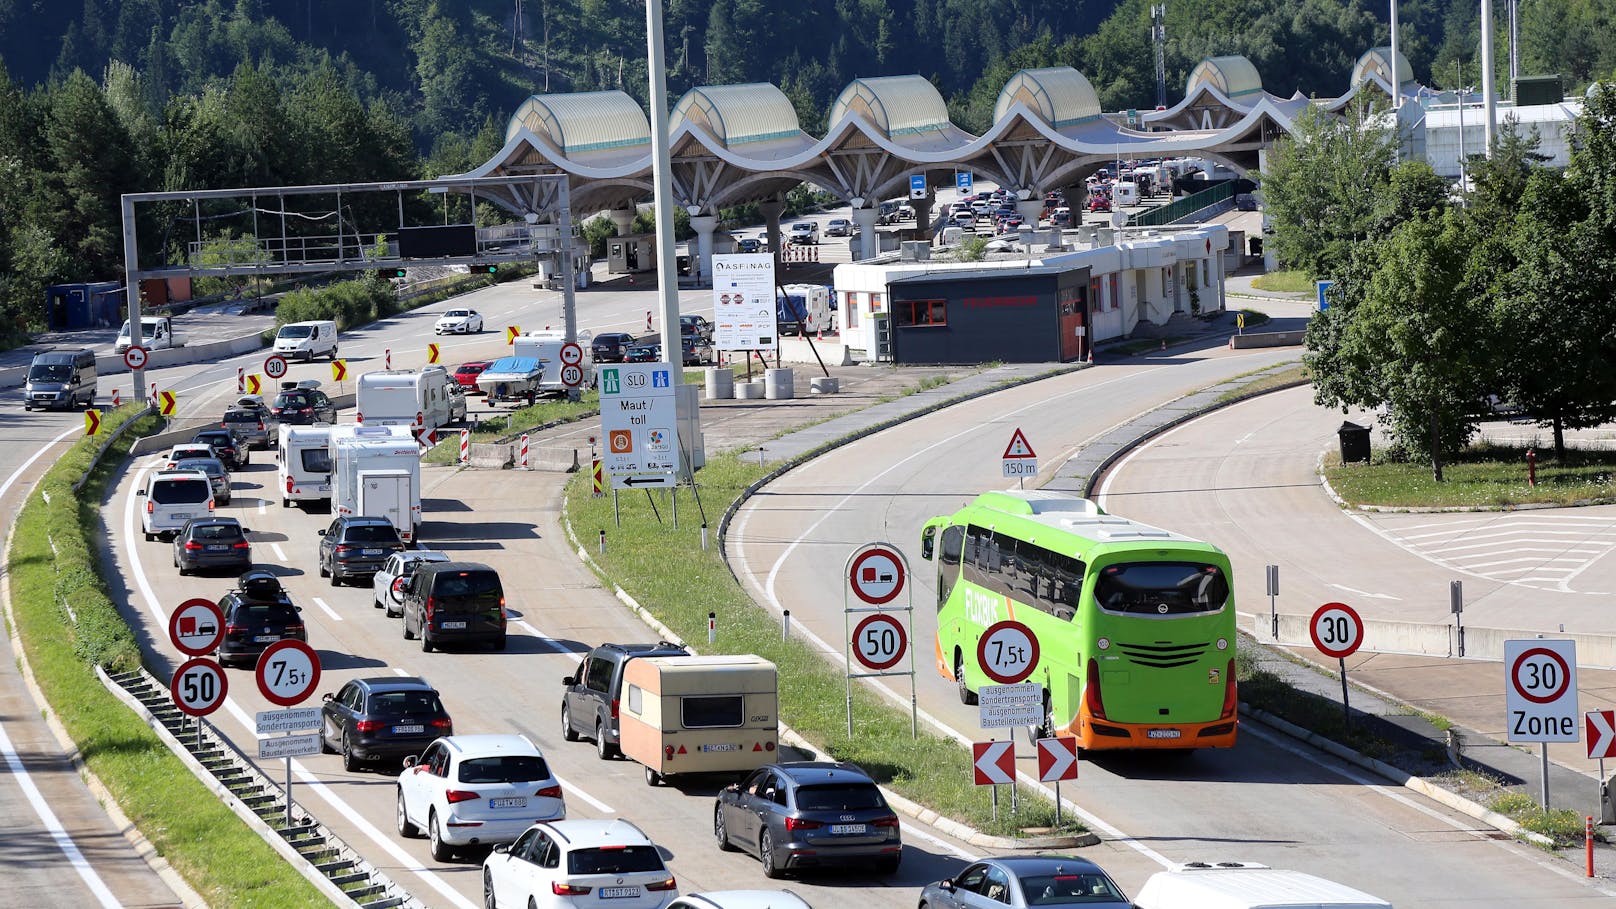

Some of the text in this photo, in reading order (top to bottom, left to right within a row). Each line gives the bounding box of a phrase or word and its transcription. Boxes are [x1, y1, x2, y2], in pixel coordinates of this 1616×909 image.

[269, 361, 281, 373] 30
[566, 369, 578, 381] 30
[627, 375, 645, 386] SLO
[620, 400, 646, 411] Maut
[630, 414, 646, 425] toll
[1005, 463, 1036, 474] 150 m
[1322, 616, 1349, 644] 30
[866, 629, 895, 656] 50
[1526, 662, 1556, 689] 30
[184, 672, 215, 703] 50
[985, 684, 1035, 695] ausgenommen
[981, 694, 1041, 705] Sondertransporte
[262, 709, 316, 723] ausgenommen
[982, 716, 1041, 727] Baustellenverkehr
[256, 719, 321, 733] Sondertransporte
[1513, 710, 1573, 735] Zone
[265, 737, 313, 750] Ausgenommen
[261, 746, 318, 758] Baustellenverkehr
